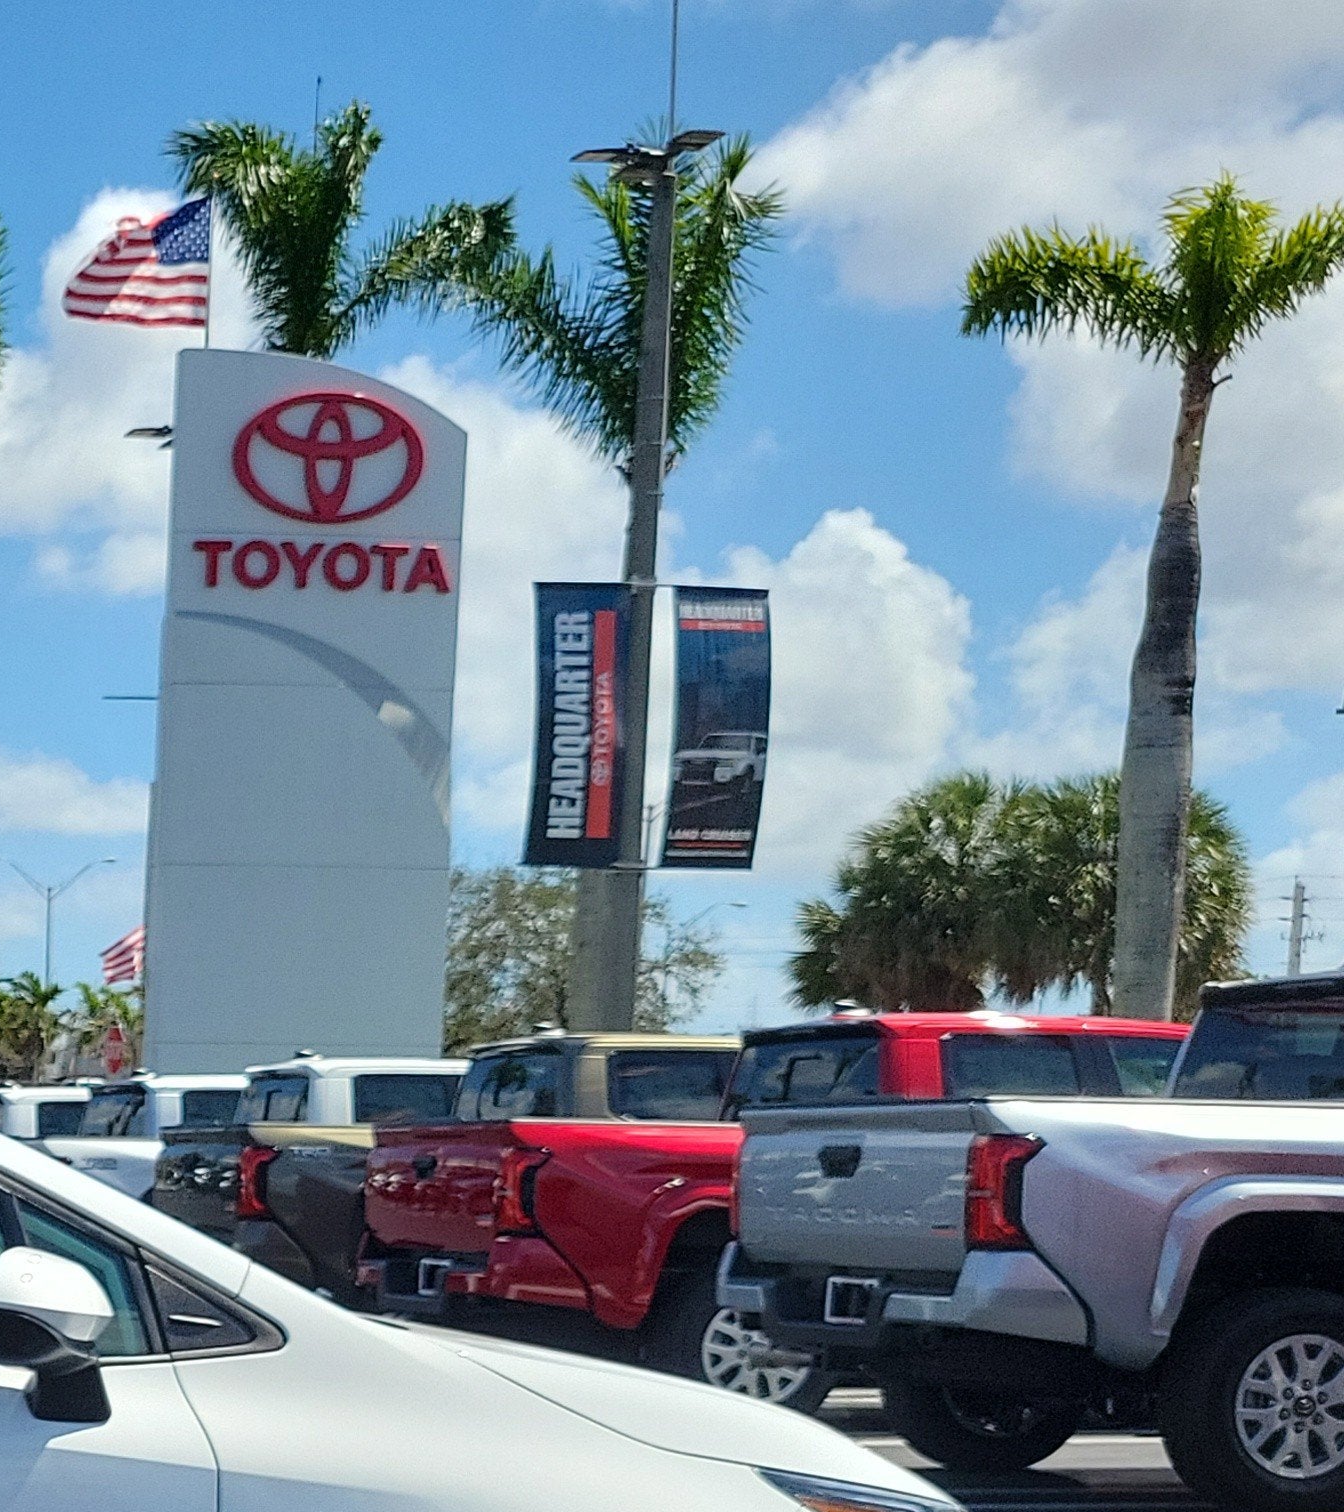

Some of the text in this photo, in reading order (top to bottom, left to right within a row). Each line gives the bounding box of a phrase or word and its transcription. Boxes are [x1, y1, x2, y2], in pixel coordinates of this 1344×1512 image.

[191, 539, 452, 594] TOYOTA
[546, 612, 591, 840] HEADQUARTER
[593, 670, 611, 759] TOYOTA
